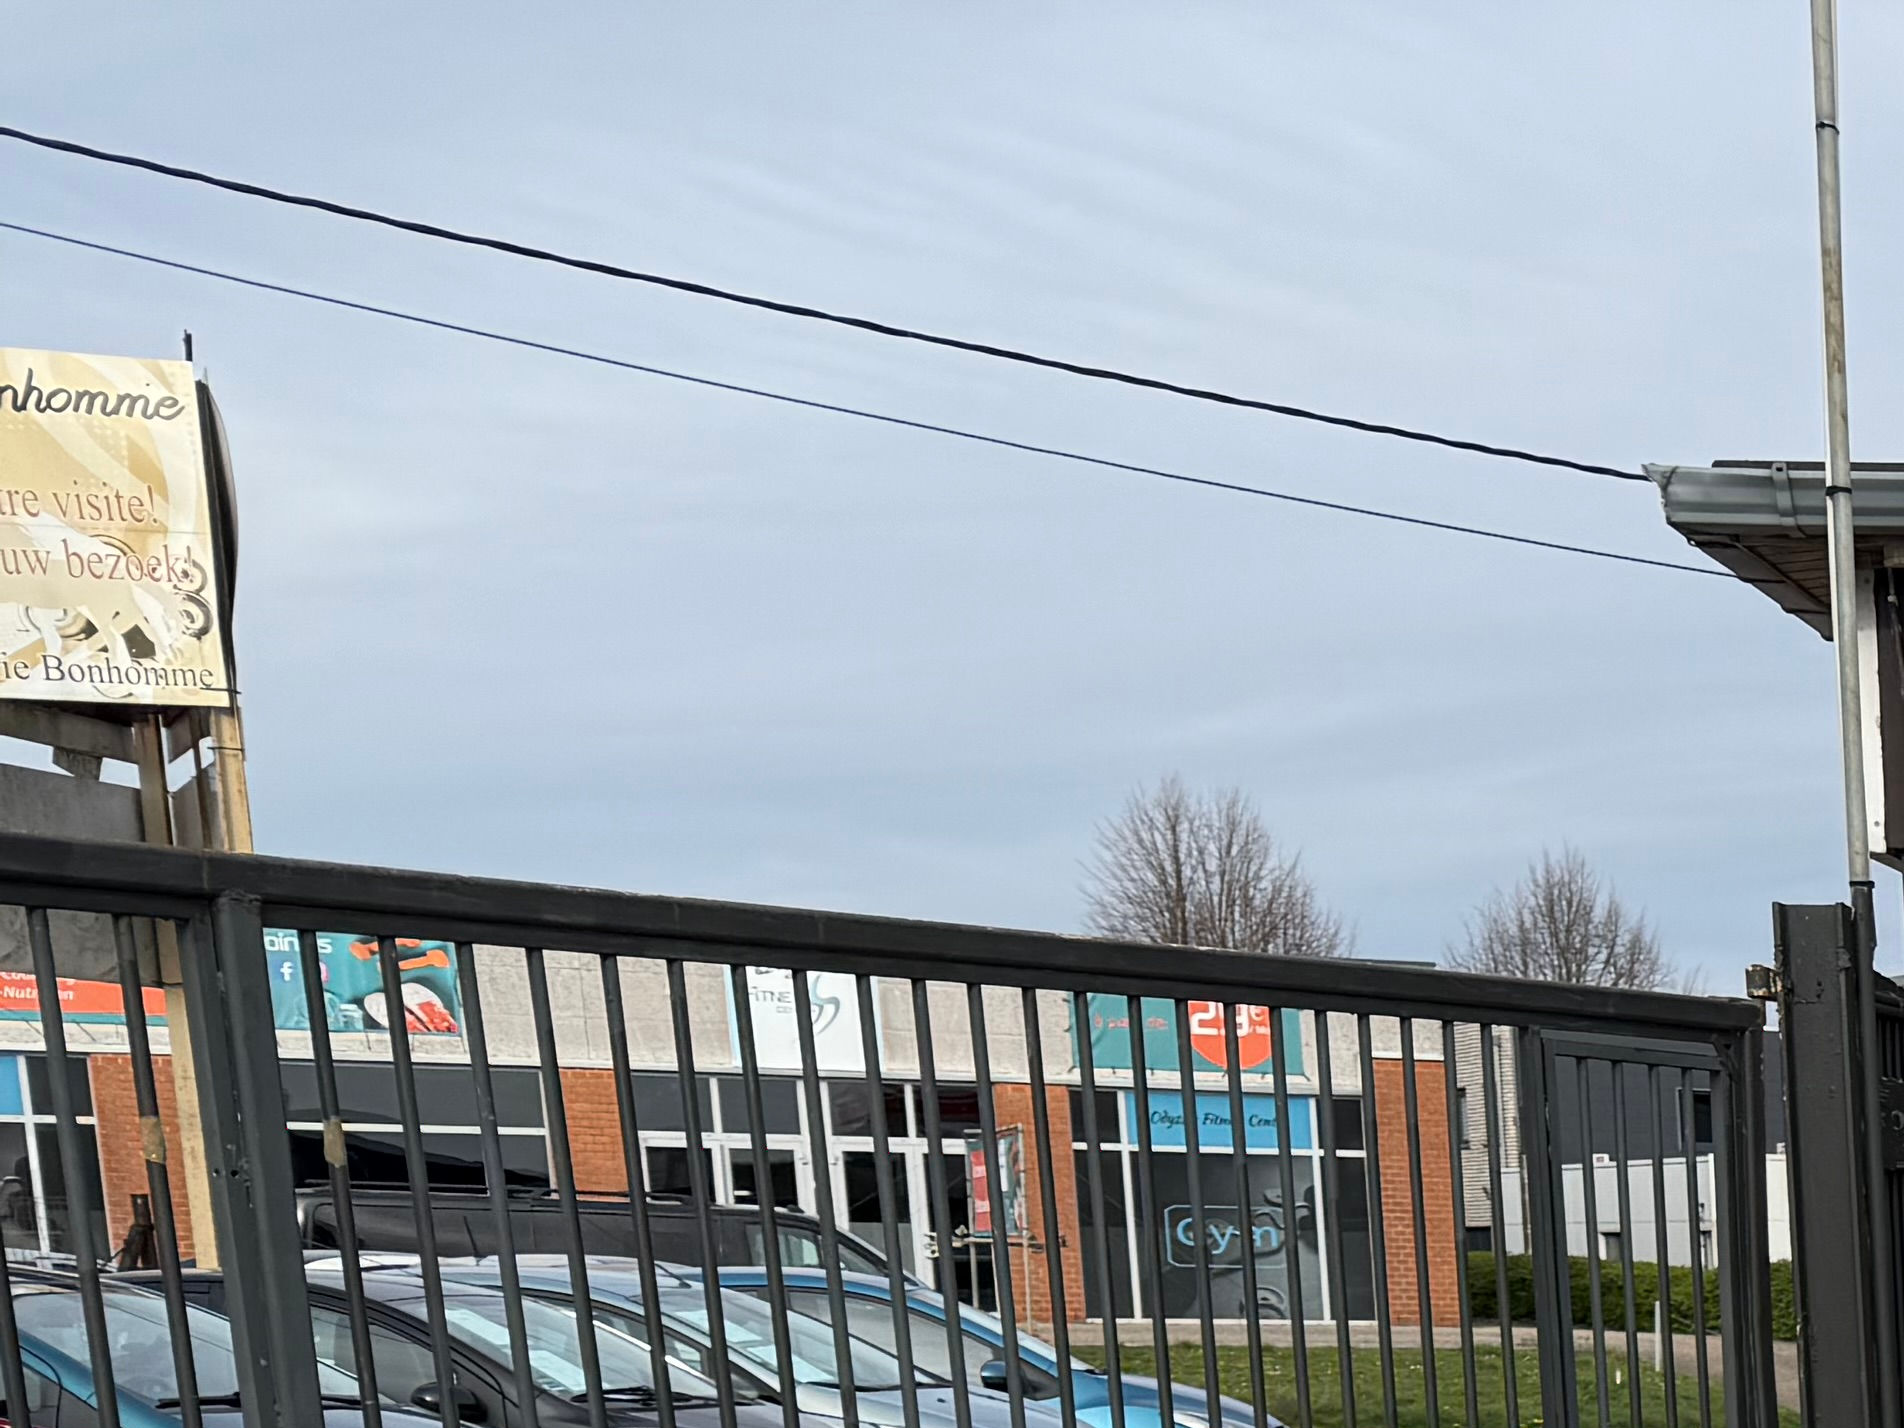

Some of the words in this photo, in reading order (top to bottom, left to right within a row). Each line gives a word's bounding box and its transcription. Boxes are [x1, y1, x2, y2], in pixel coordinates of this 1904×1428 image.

[52, 480, 158, 524] visite!
[61, 538, 194, 584] bezoek!
[41, 654, 214, 689] Bonhomme
